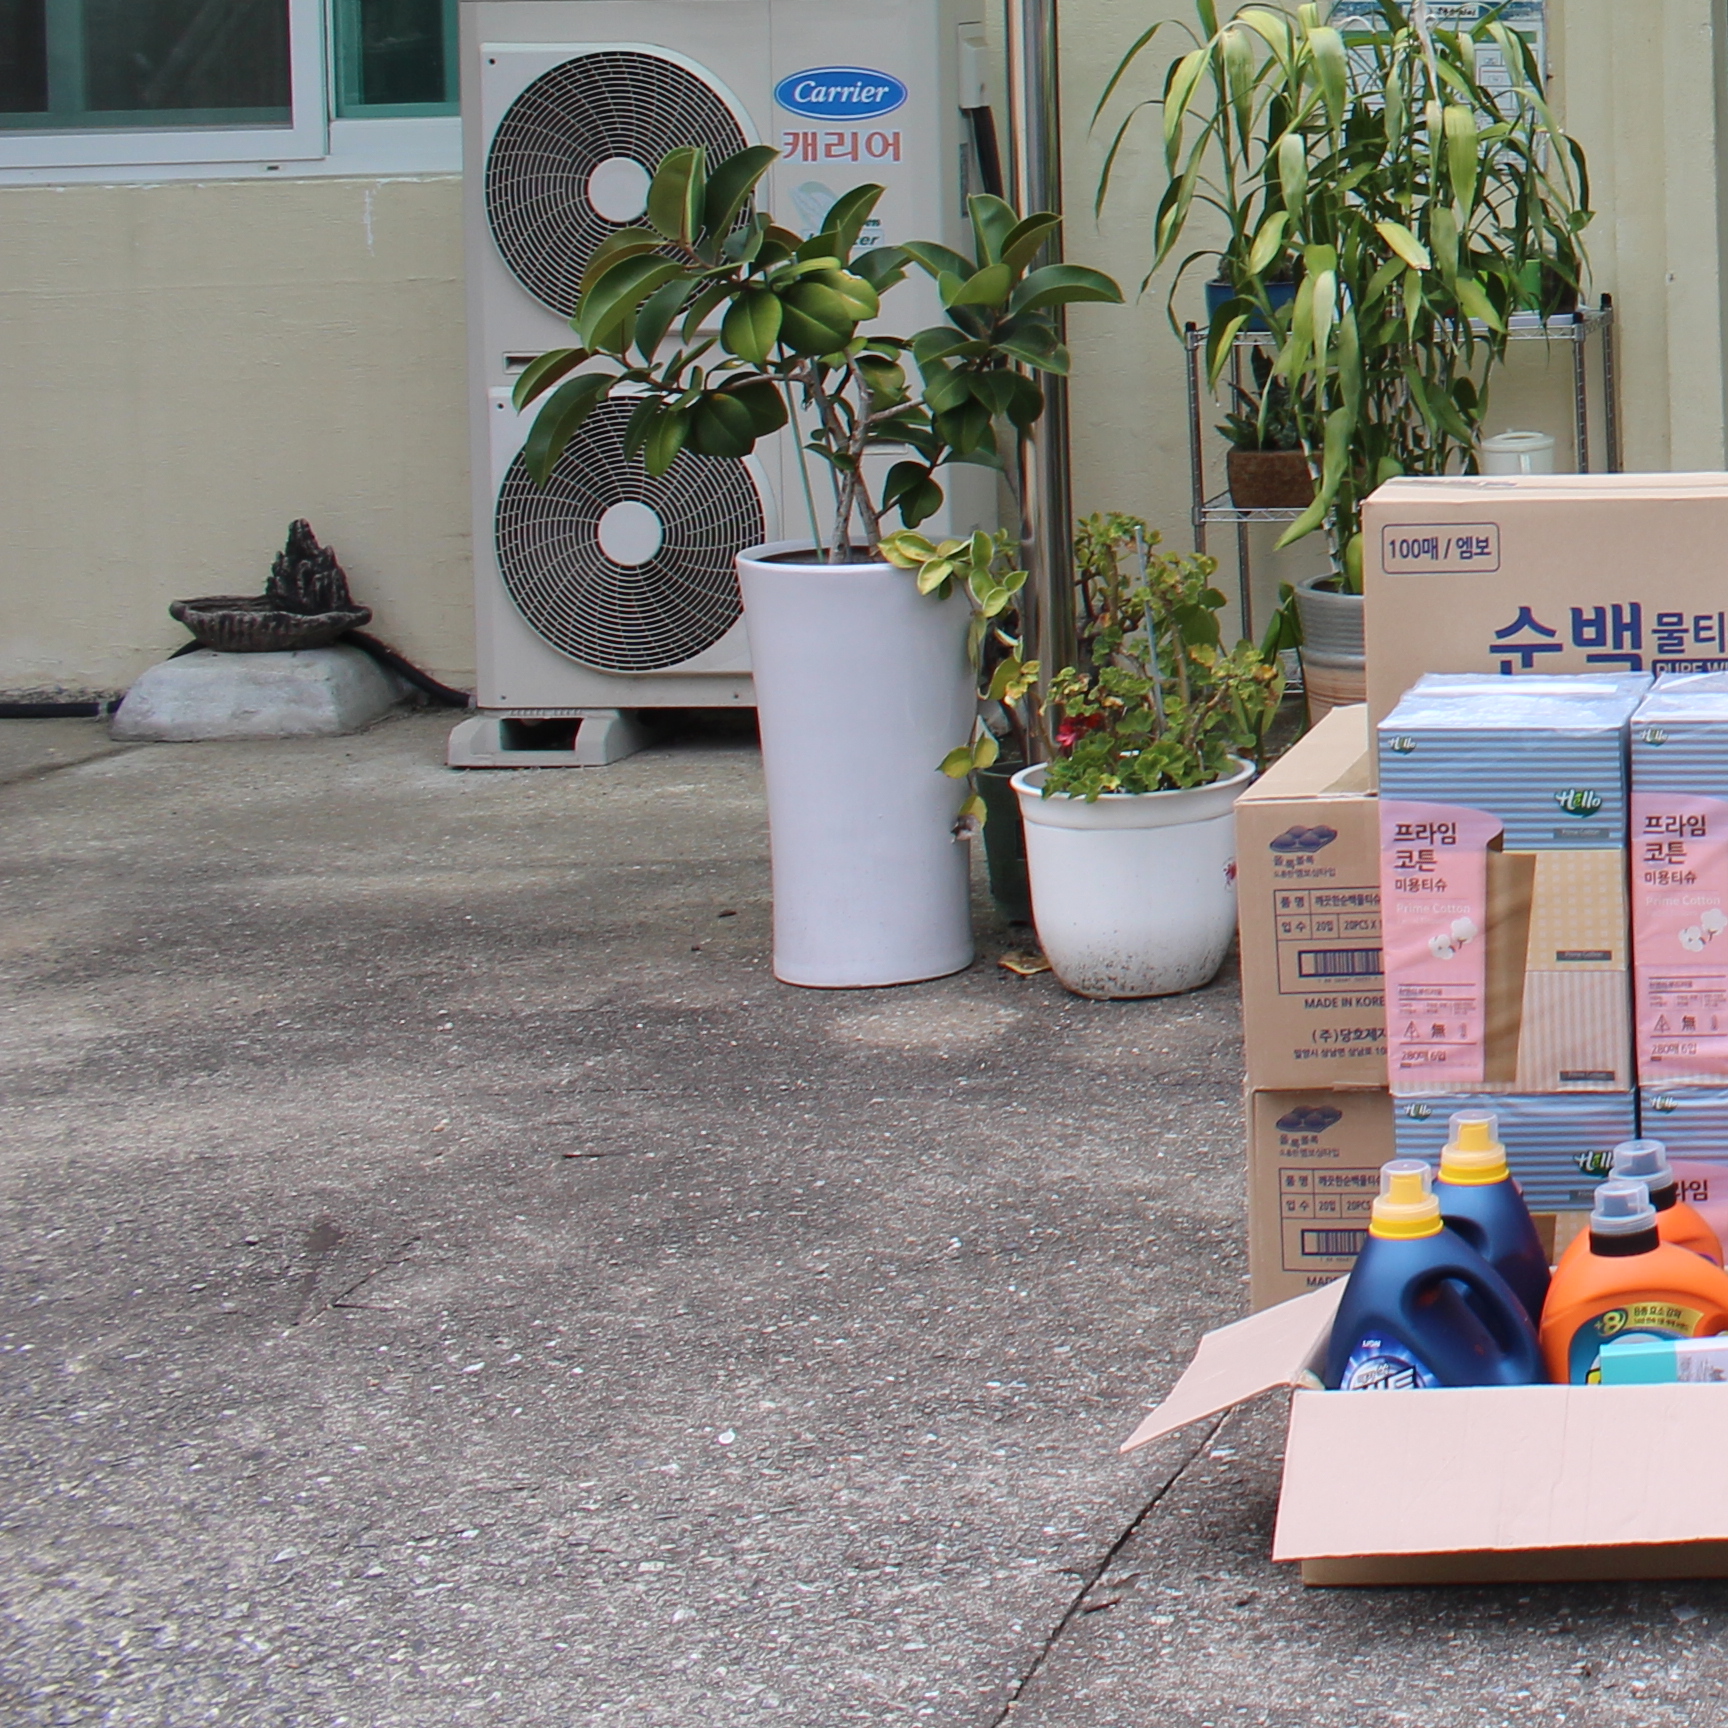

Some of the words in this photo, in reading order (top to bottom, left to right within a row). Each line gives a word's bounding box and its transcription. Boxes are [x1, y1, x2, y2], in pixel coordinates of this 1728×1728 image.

[794, 80, 889, 103] Carrier
[782, 131, 903, 162] 캐리어
[1388, 537, 1440, 561] 100매
[1455, 535, 1493, 560] 엠보
[1489, 602, 1643, 675] 순백
[1554, 788, 1602, 811] Hello
[1393, 823, 1457, 846] 프라임
[1643, 814, 1707, 838] 프라임
[1394, 849, 1437, 873] 코튼
[1643, 841, 1687, 865] 코튼
[1394, 877, 1448, 893] 미용티슈
[1644, 870, 1698, 886] 미용티슈
[1396, 903, 1430, 914] Prime
[1433, 902, 1471, 914] Cotton
[1645, 896, 1680, 907] Prime
[1682, 895, 1721, 907] Cotton
[1304, 997, 1338, 1009] MADE
[1341, 997, 1352, 1008] IN
[1355, 995, 1386, 1008] KORE
[1573, 1150, 1616, 1173] Hell
[1674, 1178, 1710, 1202] 라임
